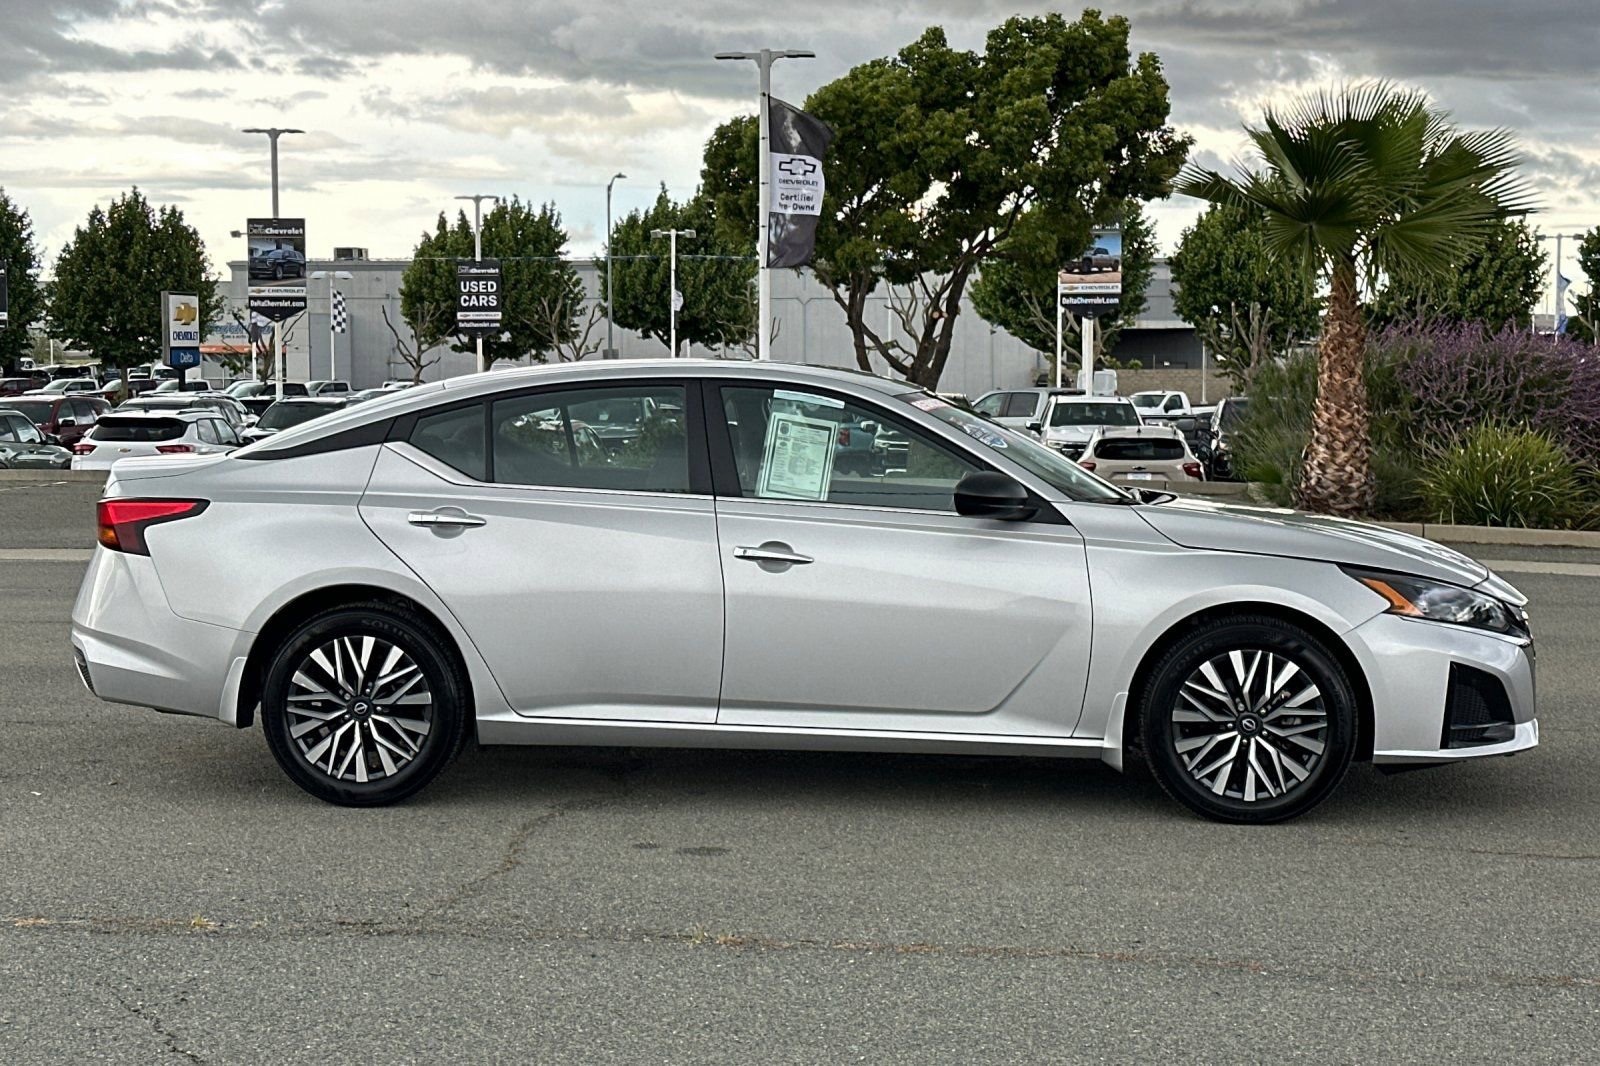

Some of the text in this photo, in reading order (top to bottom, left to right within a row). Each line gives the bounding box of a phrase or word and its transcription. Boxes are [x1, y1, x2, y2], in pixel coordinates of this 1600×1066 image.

[779, 202, 815, 211] re-Ownd
[460, 281, 497, 292] USED
[460, 295, 497, 307] CARS
[1061, 297, 1119, 305] DeltaChevrolet.com
[172, 331, 198, 340] CHEVROLET
[180, 352, 193, 362] Delta
